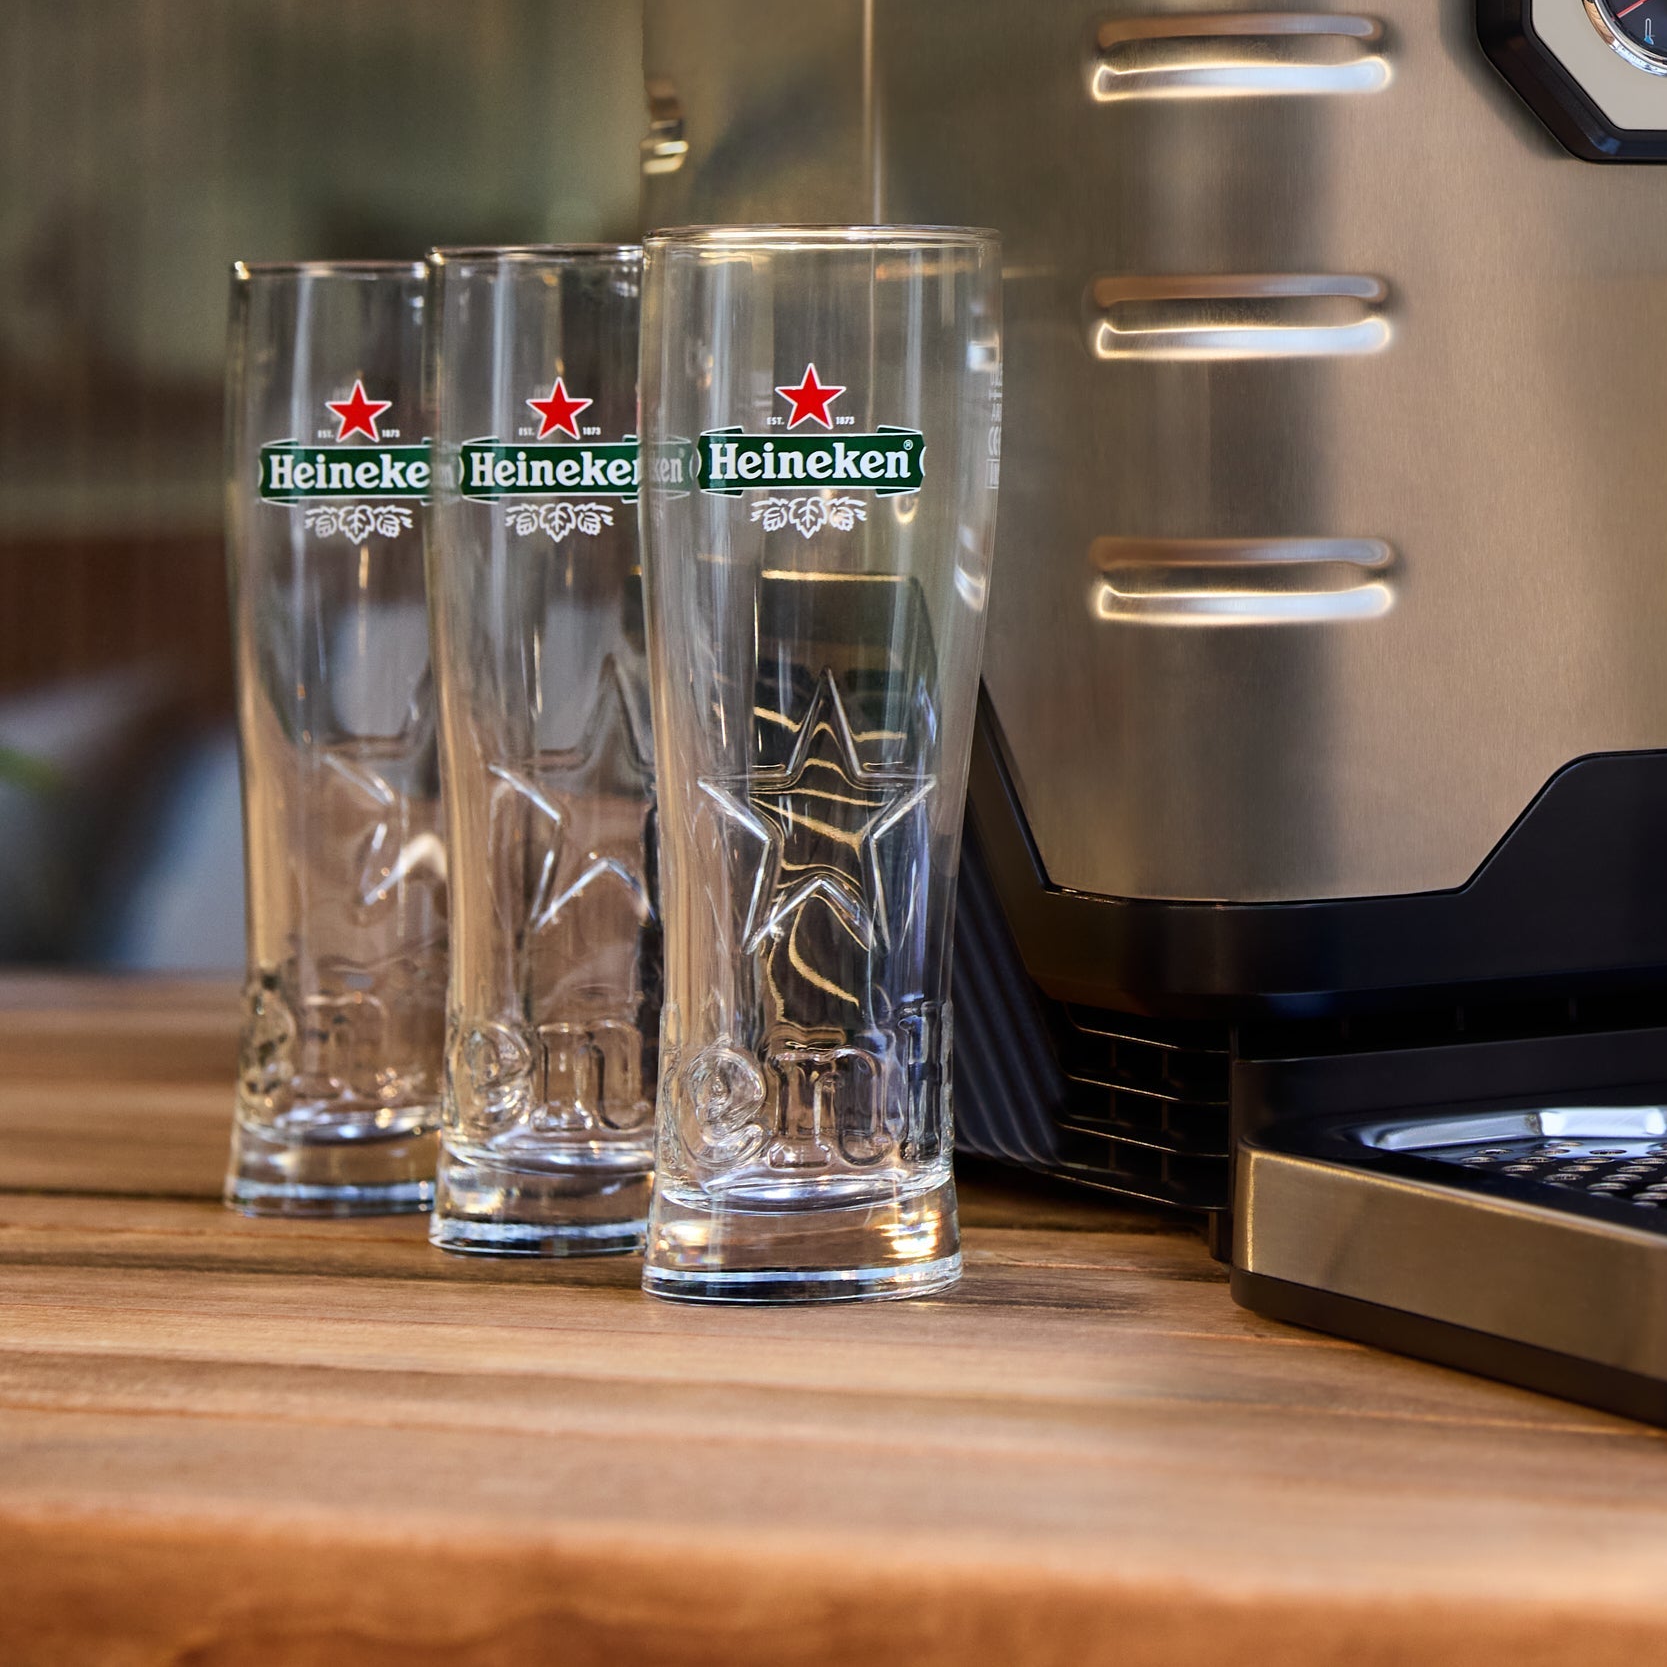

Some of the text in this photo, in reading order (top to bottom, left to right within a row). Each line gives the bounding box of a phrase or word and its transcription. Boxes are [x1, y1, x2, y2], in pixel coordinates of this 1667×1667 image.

[766, 415, 855, 426] EST. 1873
[582, 426, 601, 436] 1873
[269, 453, 431, 490] Heineke
